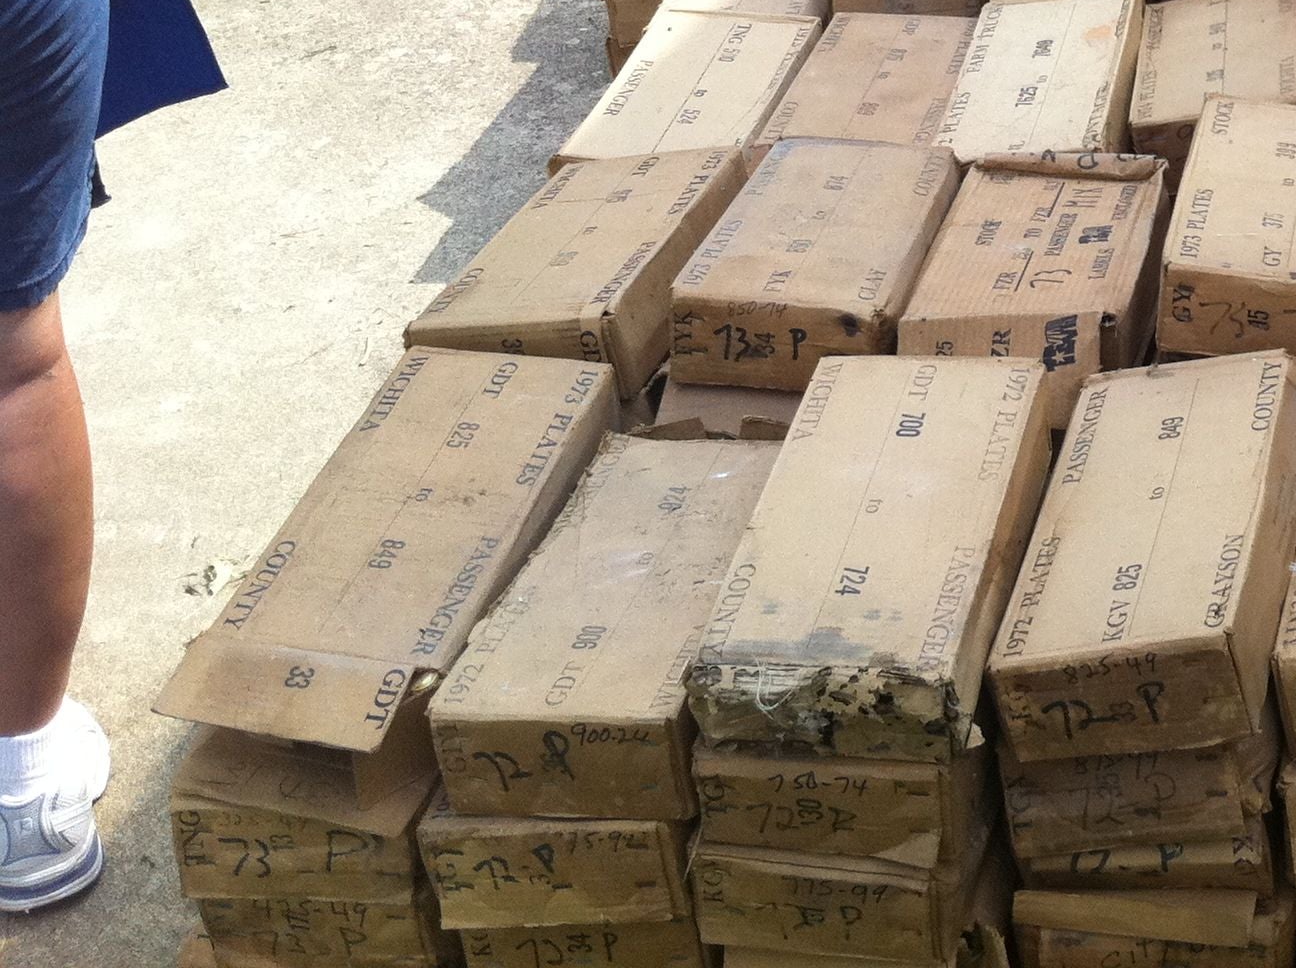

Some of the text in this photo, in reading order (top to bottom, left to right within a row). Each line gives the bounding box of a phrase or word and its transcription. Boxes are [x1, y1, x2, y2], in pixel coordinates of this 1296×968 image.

[603, 59, 654, 117] PASSENGER
[945, 90, 972, 132] PLATES
[965, 36, 989, 74] FARM
[1015, 86, 1039, 109] 7625
[1210, 100, 1235, 137] STOCK
[599, 174, 712, 305] PLATES PASSENGER
[857, 153, 949, 303] CLAY COUNTY
[1043, 211, 1080, 258] PASSENGER
[1179, 229, 1203, 260] 1973
[1187, 187, 1215, 231] PLATES
[682, 217, 745, 287] 1973 PLATES
[1087, 247, 1115, 281] LABELS
[1262, 245, 1283, 269] GY
[429, 266, 485, 315] COUNTY
[563, 367, 600, 407] 1973
[367, 361, 519, 571] GDT 825 to 849
[515, 411, 576, 487] PLATES
[834, 363, 939, 597] GDT 700 to 724
[222, 355, 430, 632] WICHITA COUNTY
[704, 360, 844, 659] WICHITA COUNTY
[917, 367, 1031, 673] 1972 PLATES PASSENGER
[1002, 386, 1110, 659] 1972 PLATES PASSENGER
[1102, 415, 1186, 645] KGV 825 to 849
[1203, 361, 1283, 630] GRAYSON COUNTY
[410, 535, 501, 656] PASSENGER
[544, 485, 688, 709] GDT 900 924
[284, 664, 316, 690] 33
[363, 667, 409, 730] GDT
[443, 662, 486, 706] 1972
